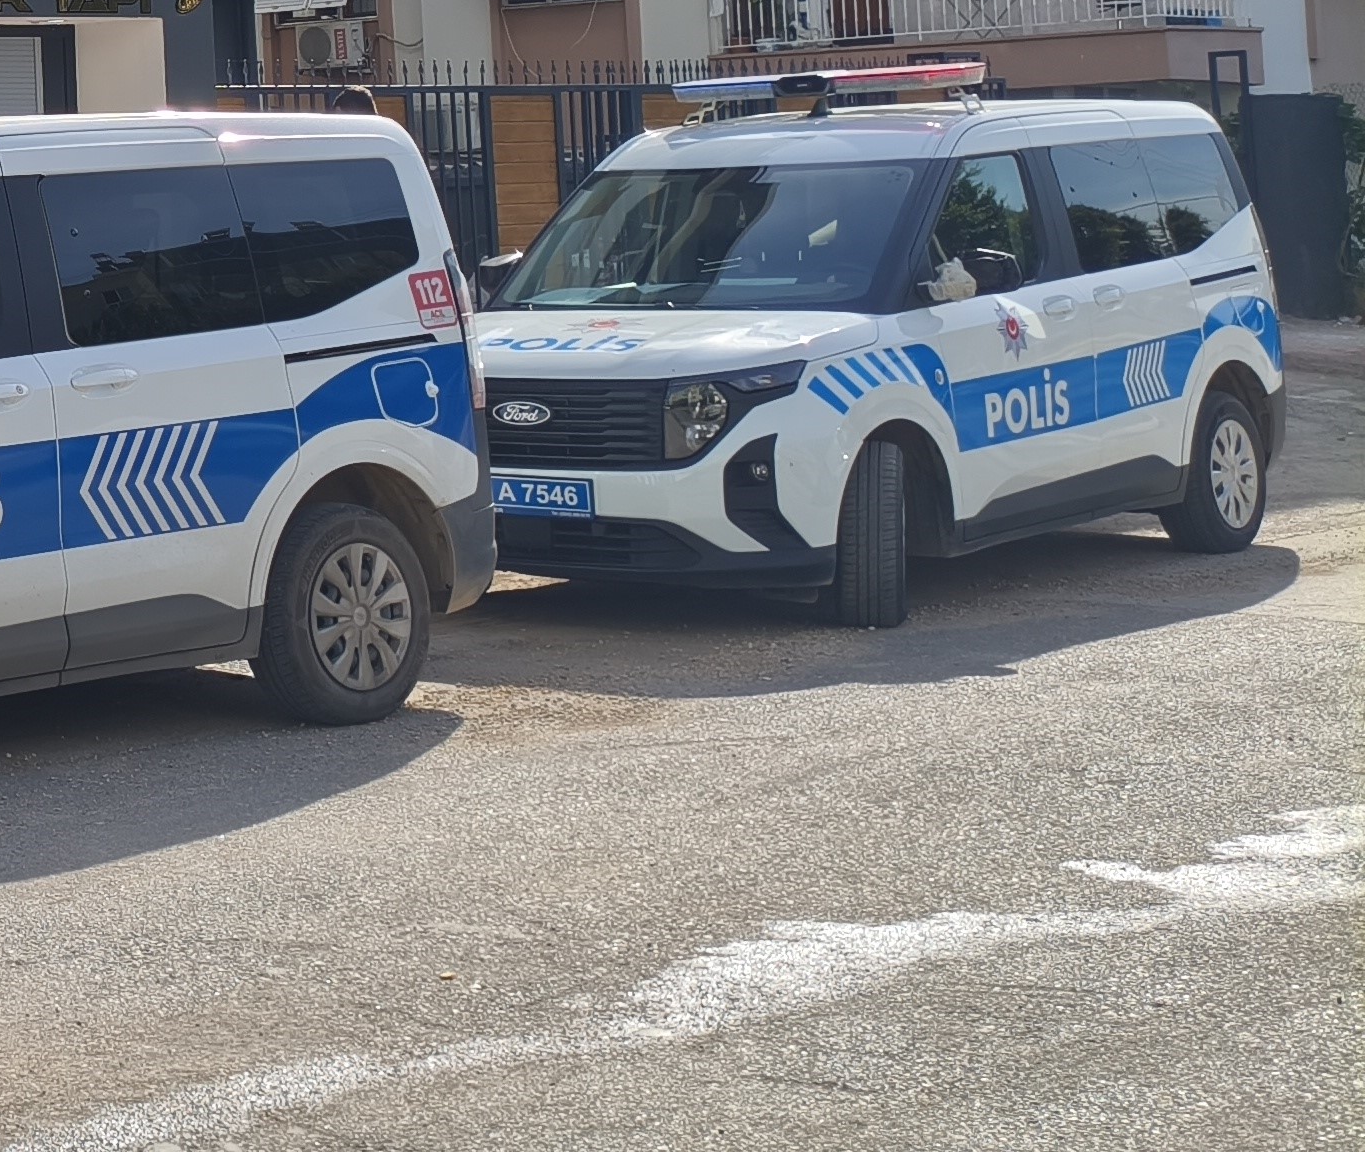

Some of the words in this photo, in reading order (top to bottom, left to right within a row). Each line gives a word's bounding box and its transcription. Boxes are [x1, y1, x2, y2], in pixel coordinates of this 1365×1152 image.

[415, 277, 448, 305] 112
[503, 404, 539, 422] Ford
[498, 481, 517, 502] A
[520, 482, 579, 506] 7546
